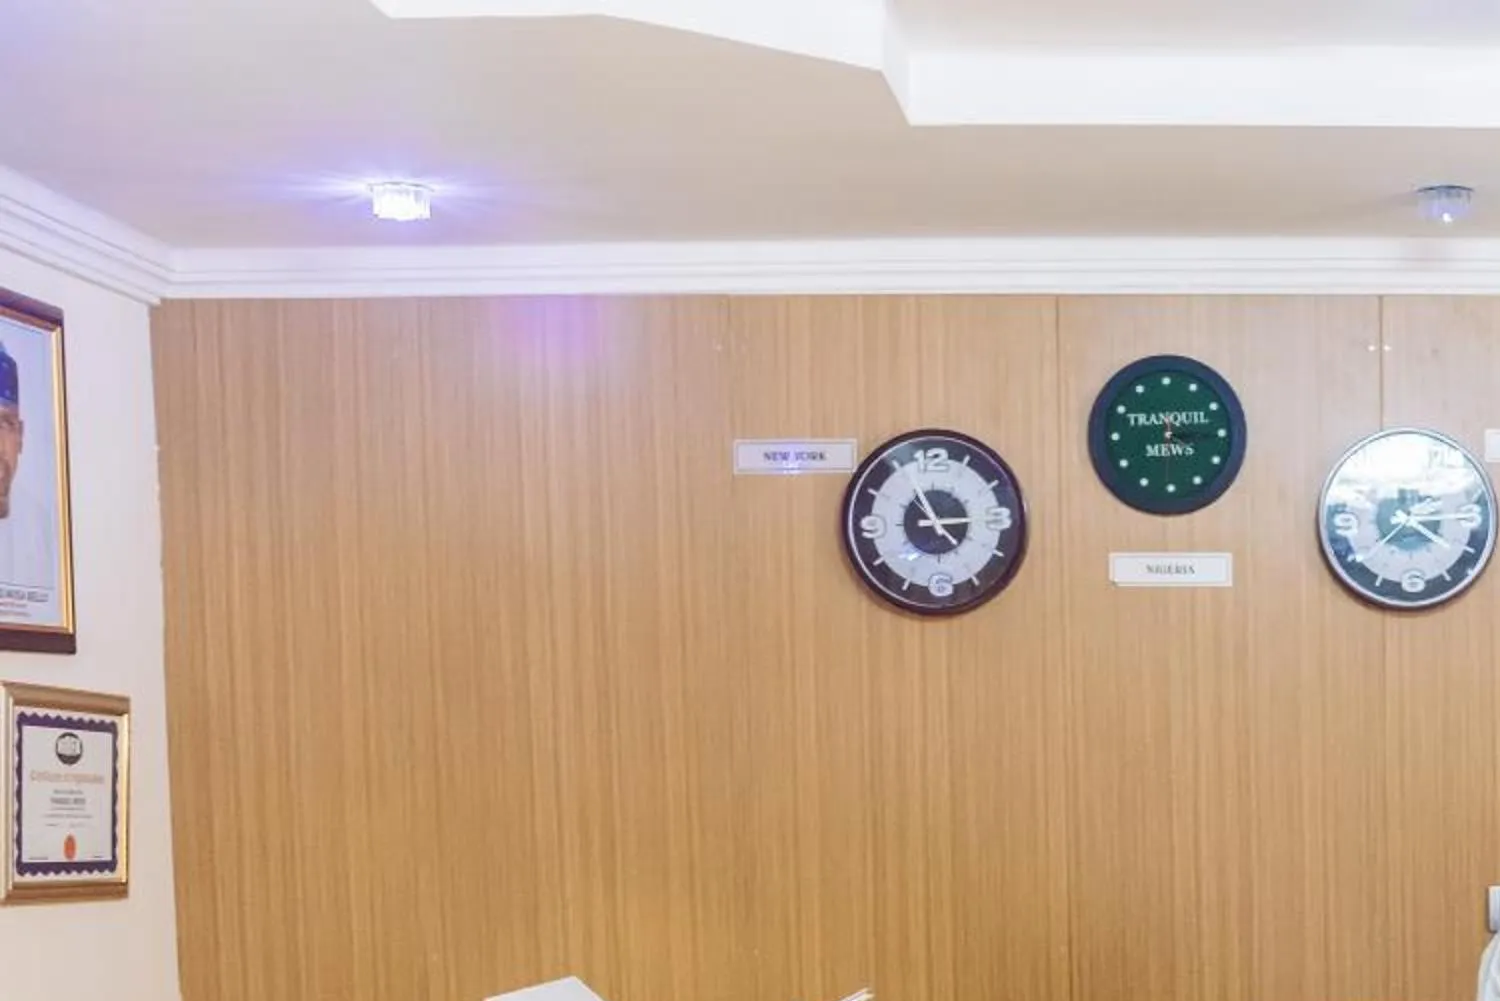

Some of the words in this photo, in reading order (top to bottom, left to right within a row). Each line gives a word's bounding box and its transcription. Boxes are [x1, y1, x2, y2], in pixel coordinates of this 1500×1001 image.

[1126, 410, 1210, 427] TRANQUIL
[763, 451, 790, 461] NEW
[794, 451, 827, 461] YORK
[914, 448, 949, 472] 12
[1145, 443, 1195, 457] MEWS
[860, 515, 886, 539] 9
[985, 507, 1012, 530] 3
[1145, 563, 1196, 575] NIGERIA
[927, 572, 953, 597] 6
[1401, 570, 1426, 593] 6
